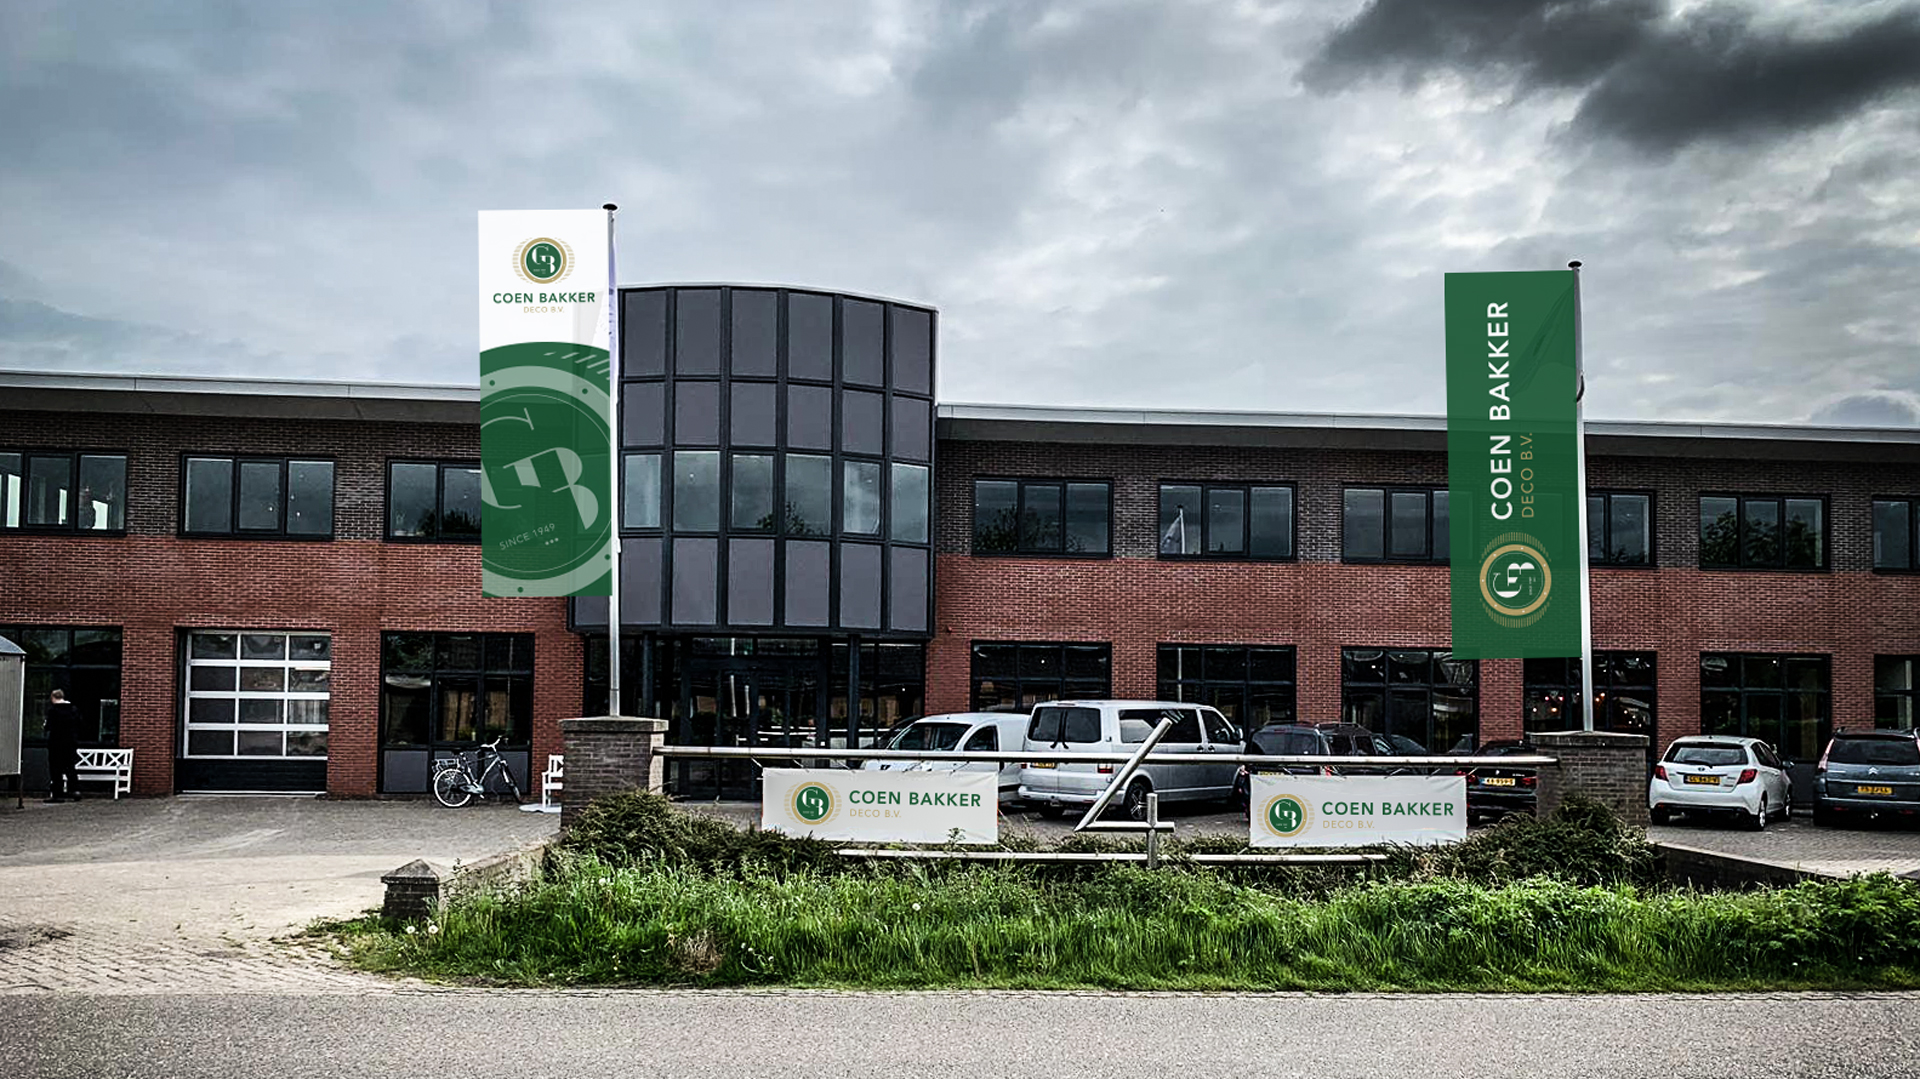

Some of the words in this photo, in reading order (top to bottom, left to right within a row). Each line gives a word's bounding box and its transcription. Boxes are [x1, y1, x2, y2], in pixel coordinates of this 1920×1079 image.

[493, 293, 533, 304] COEN
[540, 292, 595, 303] BAKKER
[523, 306, 548, 314] DECO
[550, 306, 565, 314] B.V.
[1487, 302, 1510, 420] BAKKER
[1520, 433, 1533, 460] B.V.
[1490, 435, 1513, 520] COEN
[1521, 468, 1534, 517] DECO
[499, 532, 530, 551] SINCE
[532, 523, 556, 537] 1949
[849, 790, 900, 805] COEN
[909, 792, 980, 807] BAKKER
[1322, 802, 1373, 815] COEN
[1382, 802, 1453, 816] BAKKER
[850, 809, 880, 817] DECO
